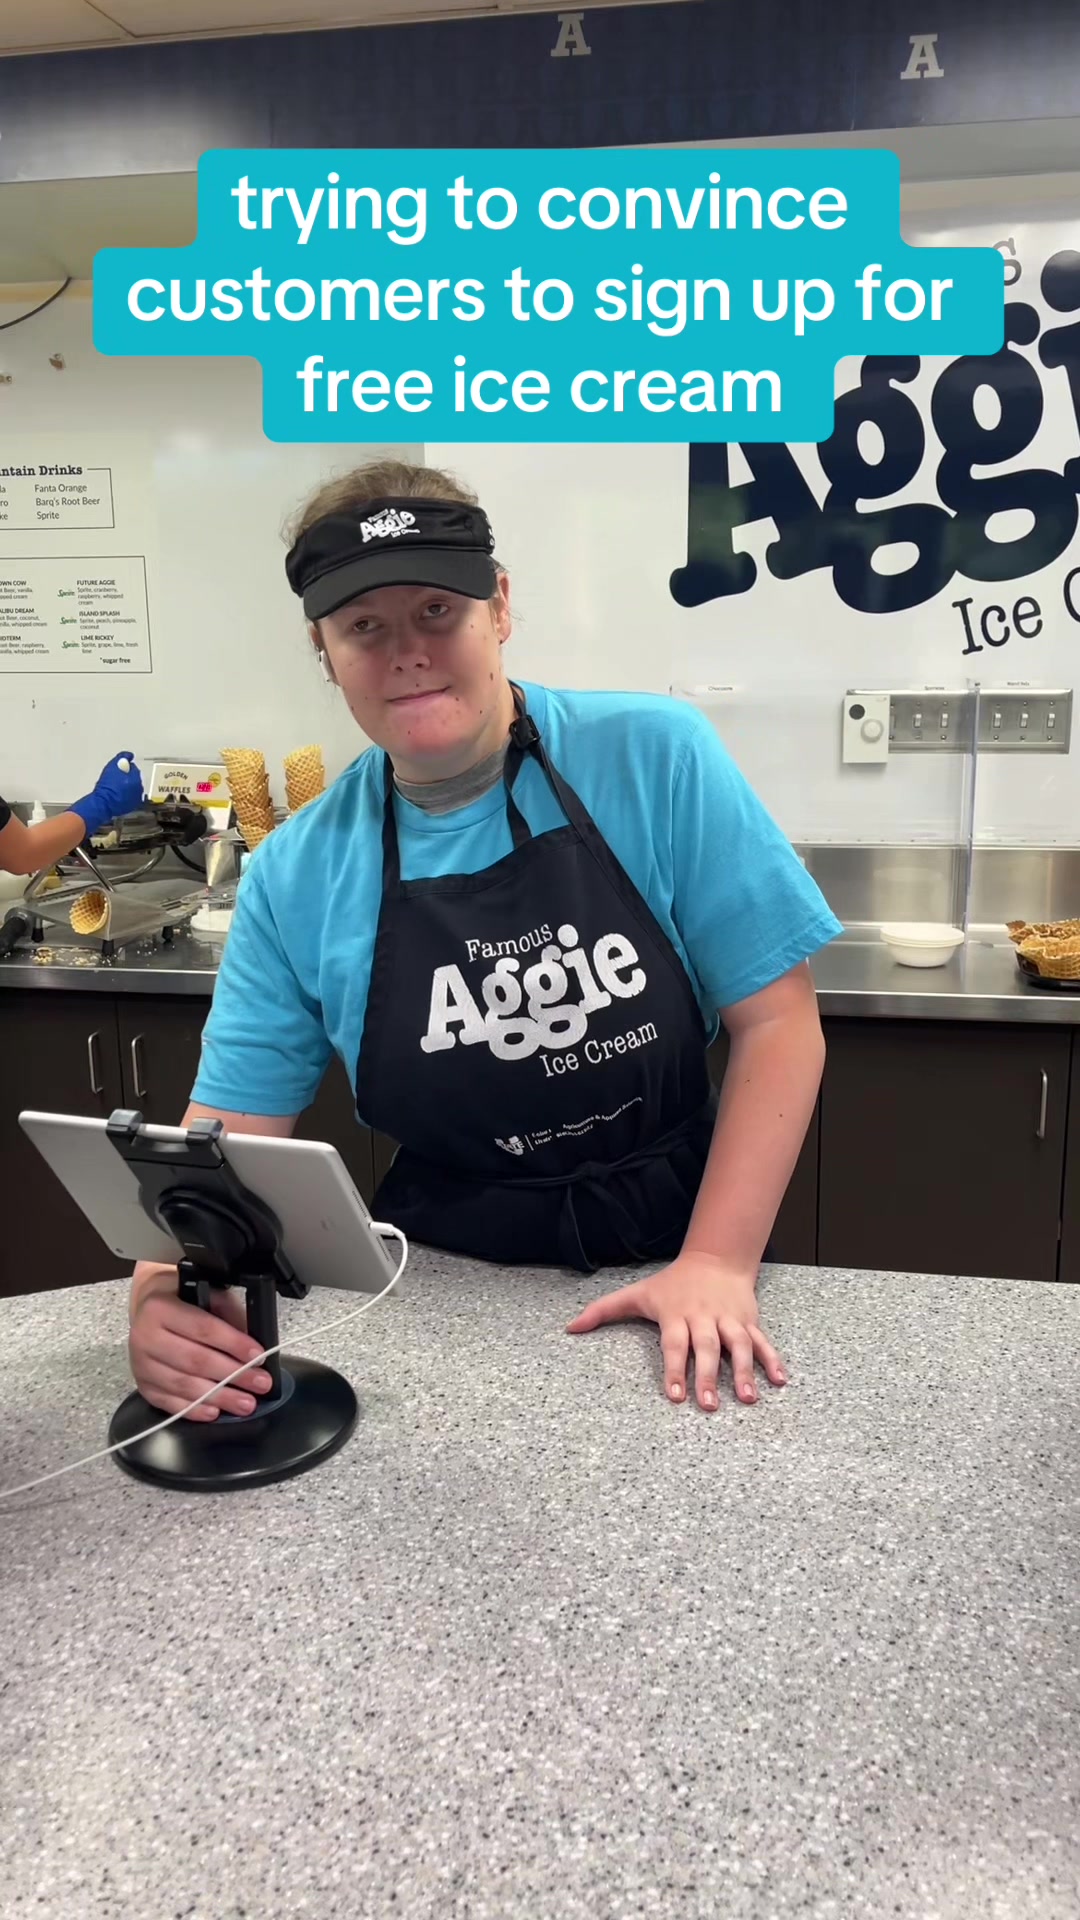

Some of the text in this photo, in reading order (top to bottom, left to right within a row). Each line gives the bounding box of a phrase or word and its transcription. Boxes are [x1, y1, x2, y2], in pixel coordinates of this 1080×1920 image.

[551, 13, 592, 57] A
[901, 34, 945, 79] A
[38, 465, 83, 476] Drinks
[34, 484, 88, 493] Fanta Orange
[35, 497, 100, 507] Barq's Root Beer
[36, 511, 60, 520] Sprite
[952, 597, 1043, 655] Ice
[164, 771, 189, 780] GOLDEN
[158, 786, 191, 794] WAFFLES
[465, 923, 553, 963] Famous
[420, 923, 647, 1061] Aggie
[539, 1022, 658, 1078] Ice Cream
